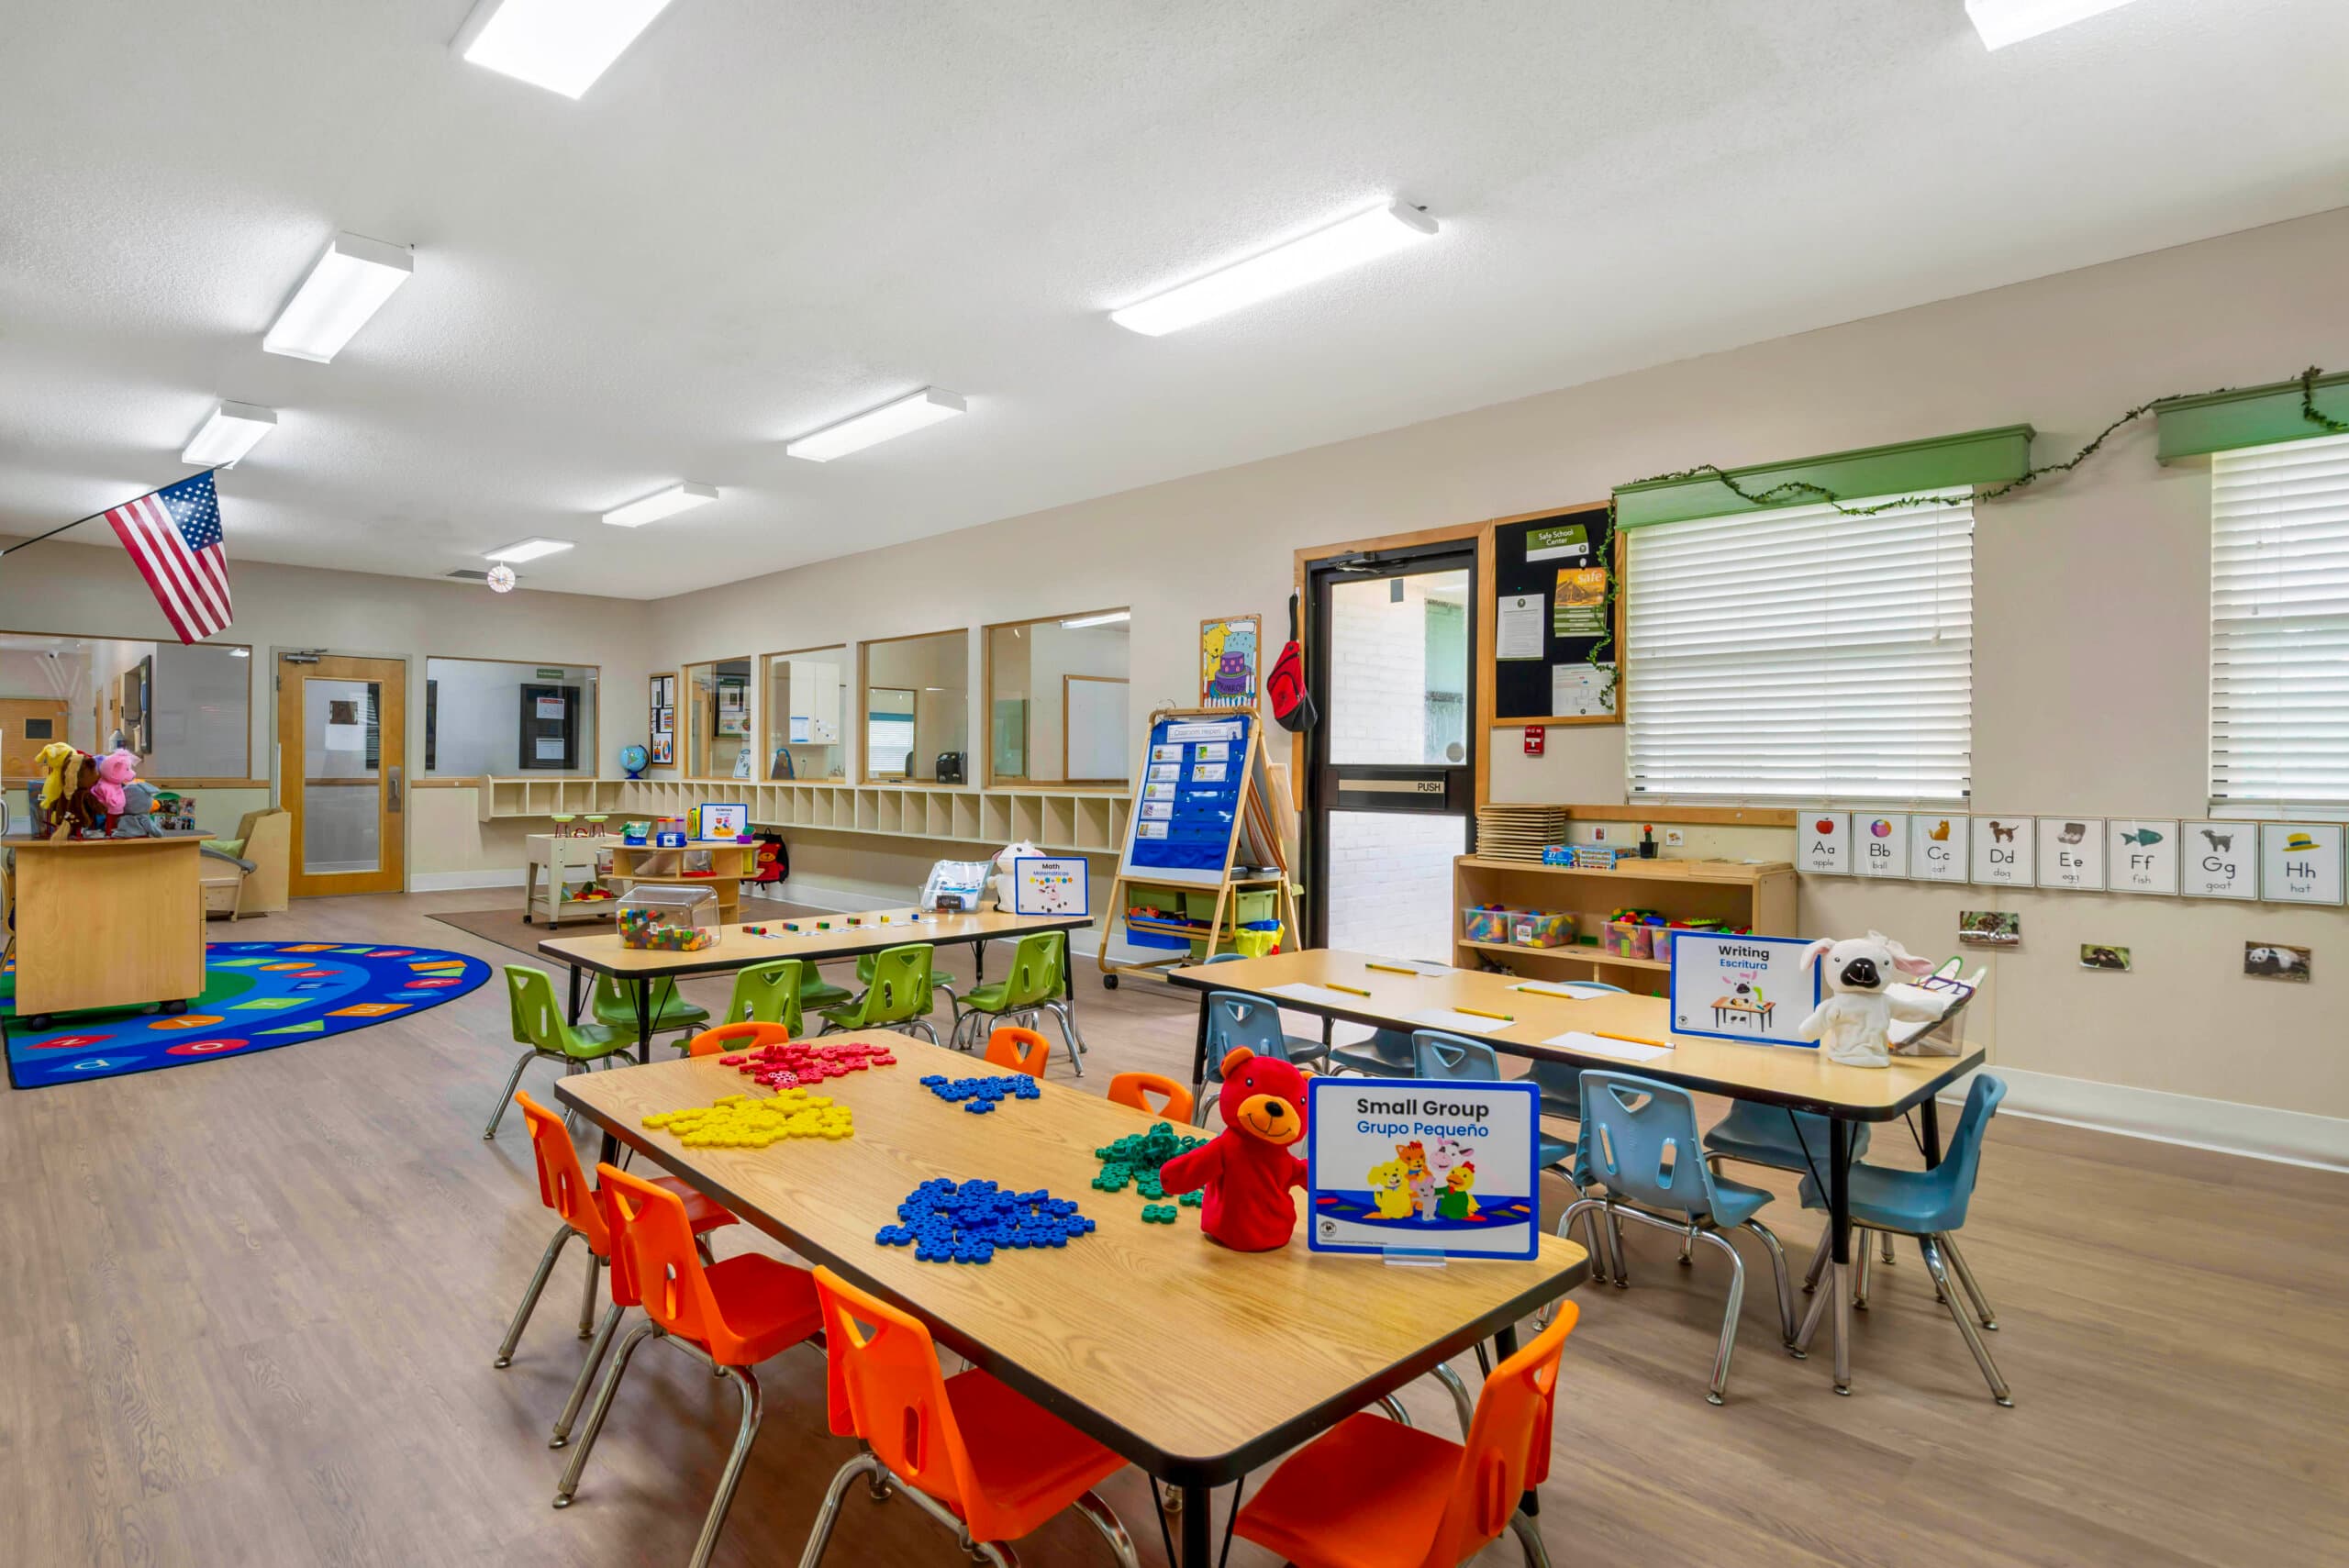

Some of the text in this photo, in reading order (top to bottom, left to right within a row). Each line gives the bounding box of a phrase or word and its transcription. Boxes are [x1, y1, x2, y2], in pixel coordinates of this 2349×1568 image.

[1538, 528, 1575, 540] Safe School
[1546, 538, 1567, 546] Center
[1578, 571, 1603, 583] safe
[1417, 783, 1441, 792] PUSH
[1812, 840, 1835, 855] Aa
[1869, 843, 1891, 858] Bb
[1927, 846, 1950, 861] Cc
[1989, 849, 2014, 863] Dd
[2060, 851, 2083, 867] Ee
[2131, 854, 2154, 870] Ff
[1812, 858, 1834, 868] apple
[1872, 861, 1887, 871] ball
[2202, 856, 2236, 879] Gg
[1993, 868, 2010, 879] dog
[2286, 862, 2316, 879] Hh
[2132, 873, 2151, 885] fish
[2206, 881, 2232, 893] goat
[2290, 883, 2311, 894] hat
[1719, 945, 1769, 961] Writing
[1720, 959, 1767, 969] Escritura
[1357, 1098, 1489, 1122] Small Group
[1357, 1120, 1489, 1139] Grupo Pequeño
